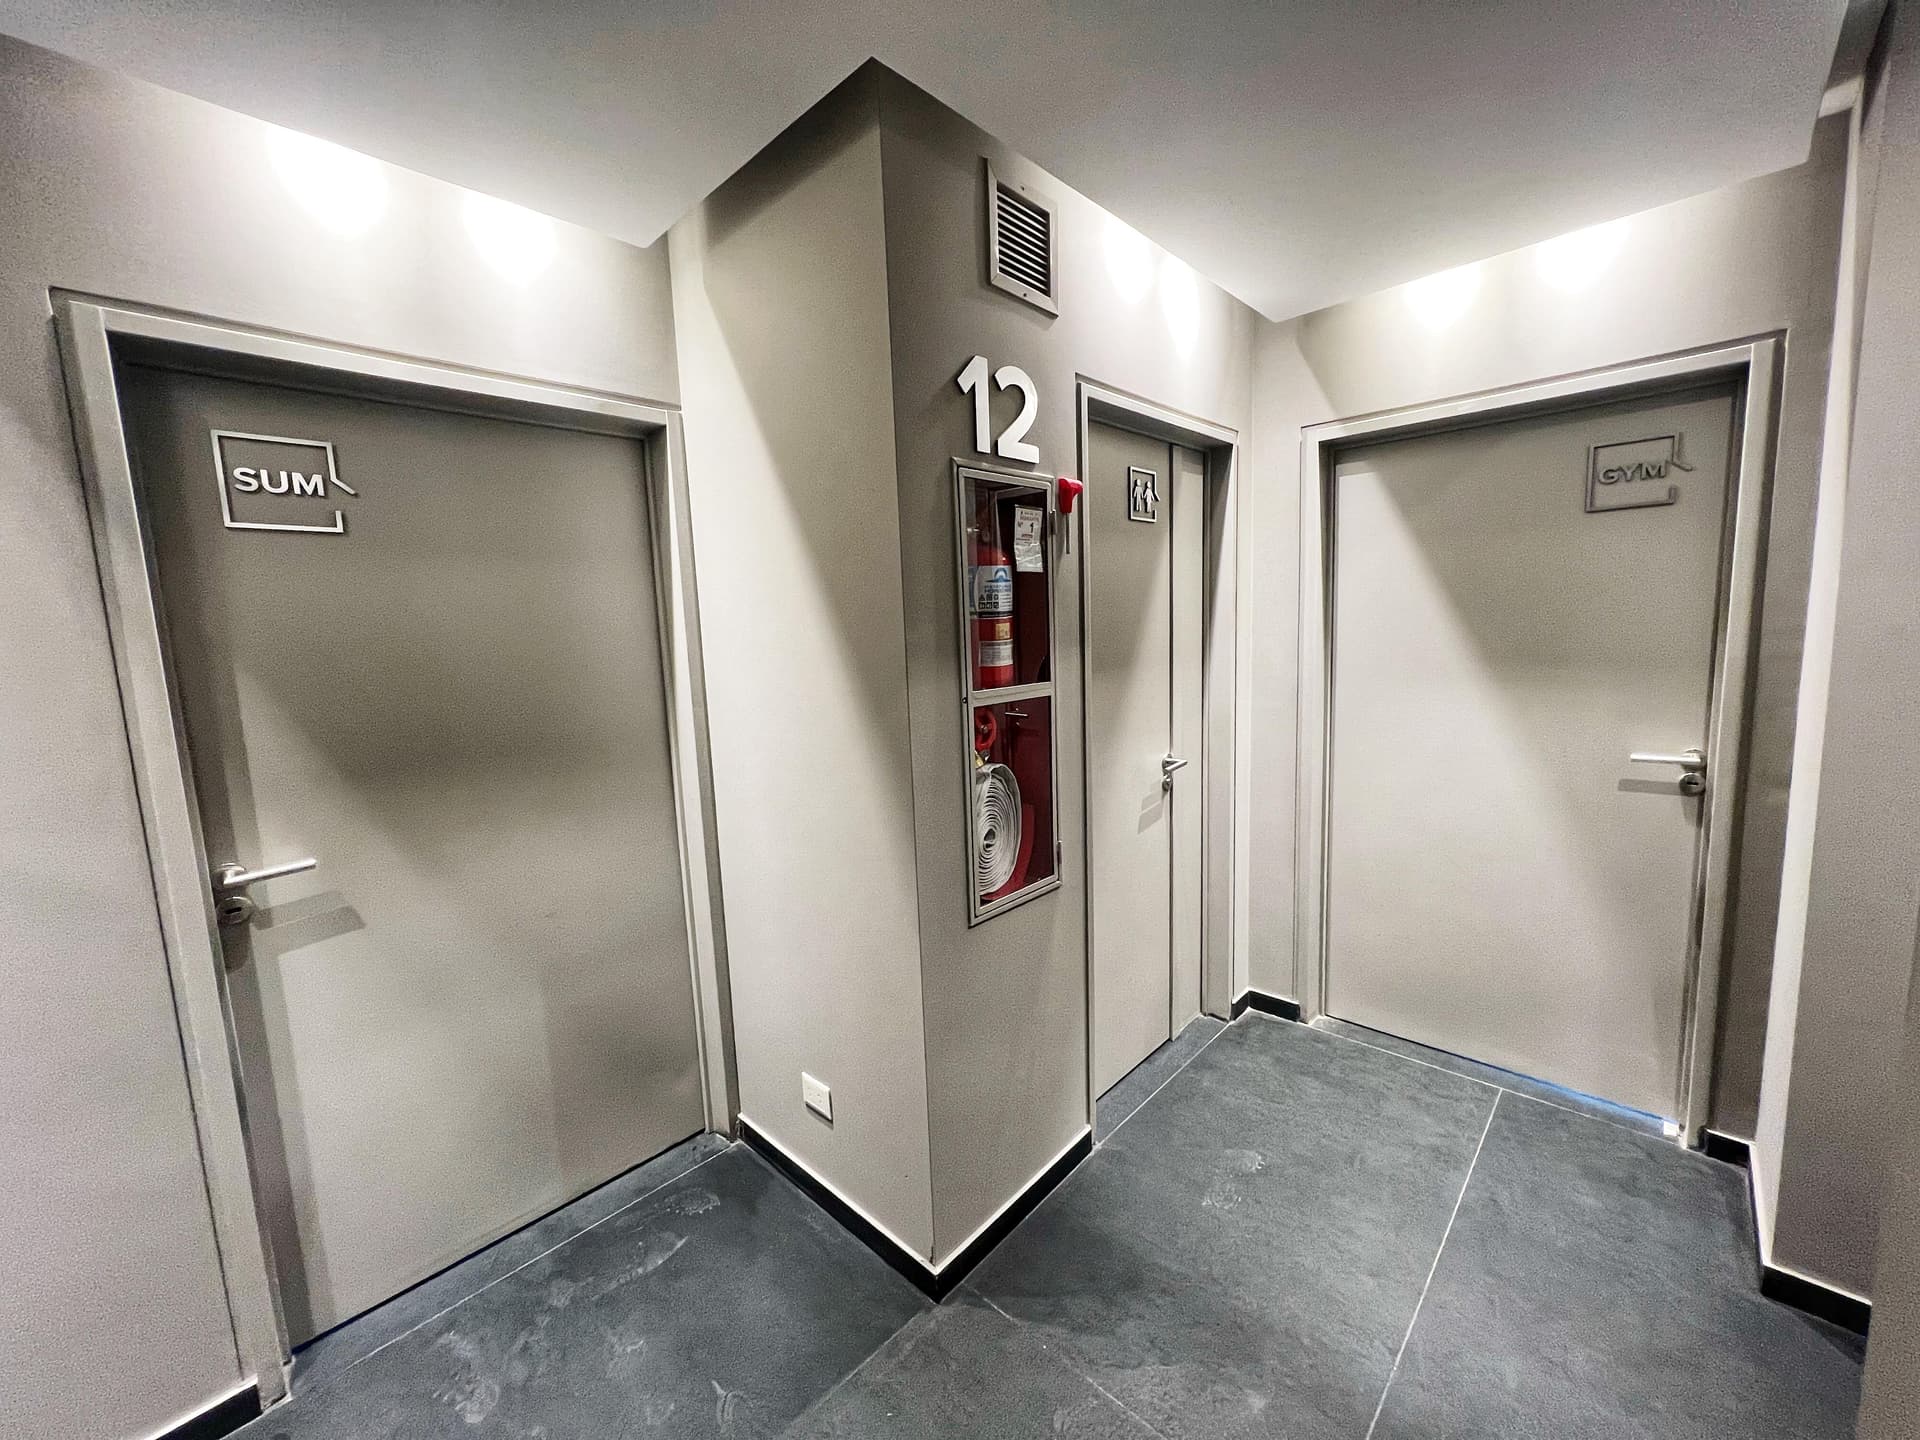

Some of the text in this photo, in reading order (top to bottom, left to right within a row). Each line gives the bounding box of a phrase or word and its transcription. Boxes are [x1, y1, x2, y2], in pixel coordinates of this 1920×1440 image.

[957, 355, 1040, 464] 12
[232, 467, 325, 497] SUM
[1599, 459, 1668, 485] GYM
